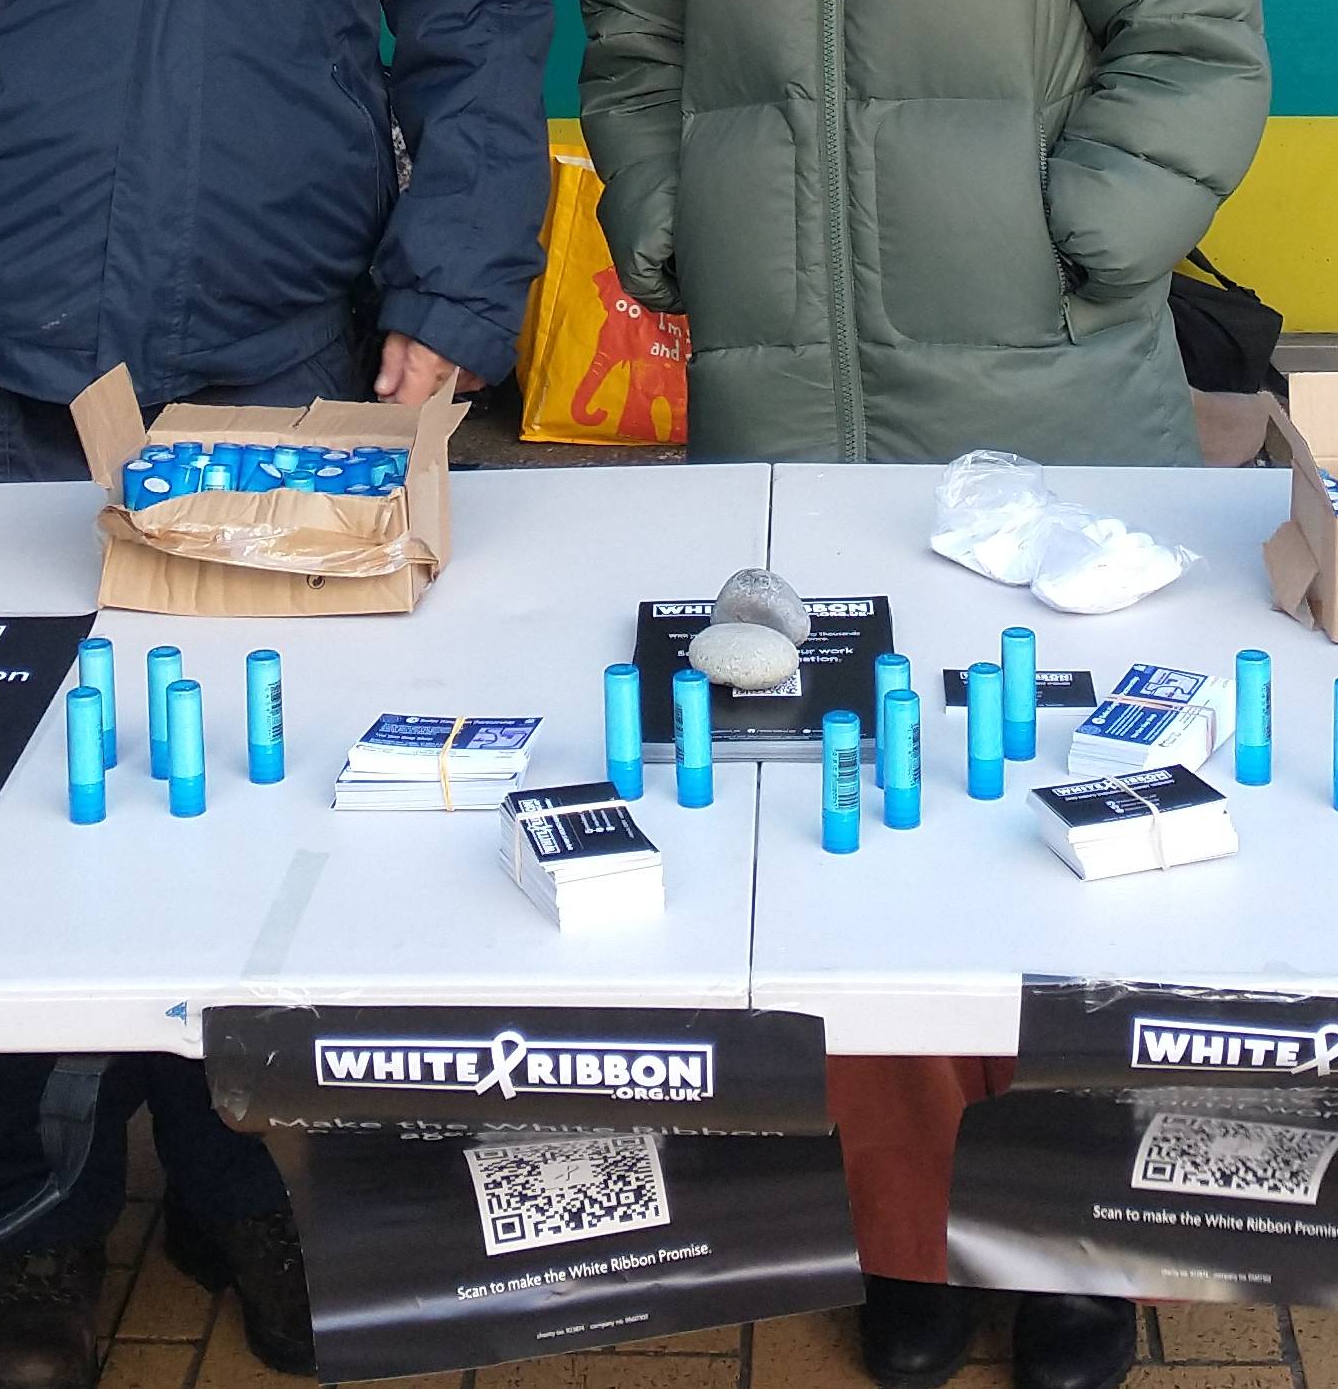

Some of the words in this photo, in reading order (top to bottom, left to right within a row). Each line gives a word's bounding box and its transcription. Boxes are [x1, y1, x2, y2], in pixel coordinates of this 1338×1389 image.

[650, 339, 680, 362] and
[1143, 1030, 1300, 1067] WHITE
[324, 1051, 479, 1084] WHITE
[527, 1053, 703, 1087] RIBBON
[611, 1086, 702, 1102] .ORG.UK
[1093, 1204, 1122, 1220] Scan
[1125, 1208, 1140, 1221] to
[1143, 1209, 1177, 1225] make
[1180, 1211, 1201, 1227] the
[1205, 1213, 1244, 1231] White
[1246, 1217, 1292, 1235] Ribbon
[457, 1286, 488, 1300] Scan
[490, 1282, 505, 1295] to
[507, 1274, 542, 1291] make
[544, 1268, 566, 1284] the
[568, 1261, 608, 1280] White
[610, 1252, 656, 1272] Ribbon
[658, 1243, 712, 1264] Promise.
